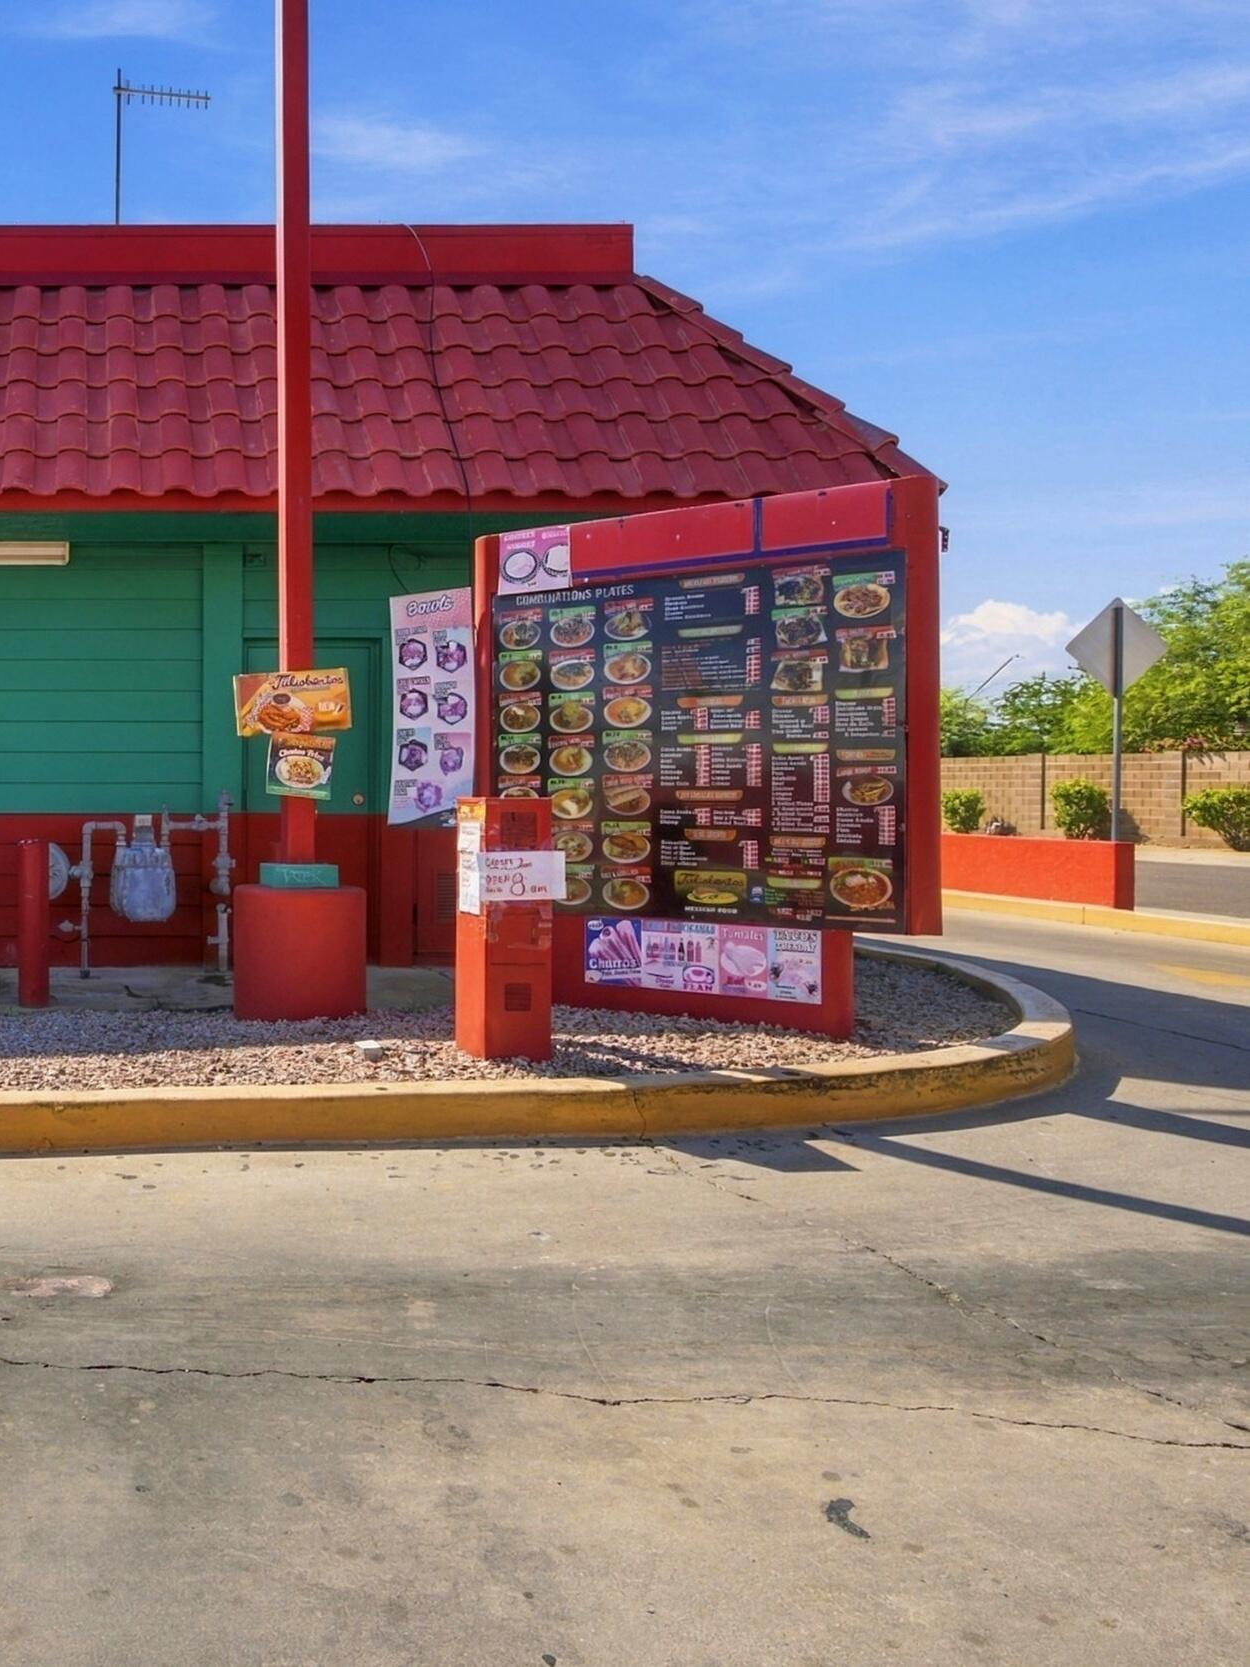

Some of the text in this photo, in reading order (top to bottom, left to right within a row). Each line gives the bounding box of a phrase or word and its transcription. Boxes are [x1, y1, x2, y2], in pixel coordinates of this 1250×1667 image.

[516, 584, 634, 606] COMBINATIONS PLATES
[406, 594, 454, 617] Bowls
[774, 929, 818, 943] TACOS
[683, 983, 713, 992] FLAN
